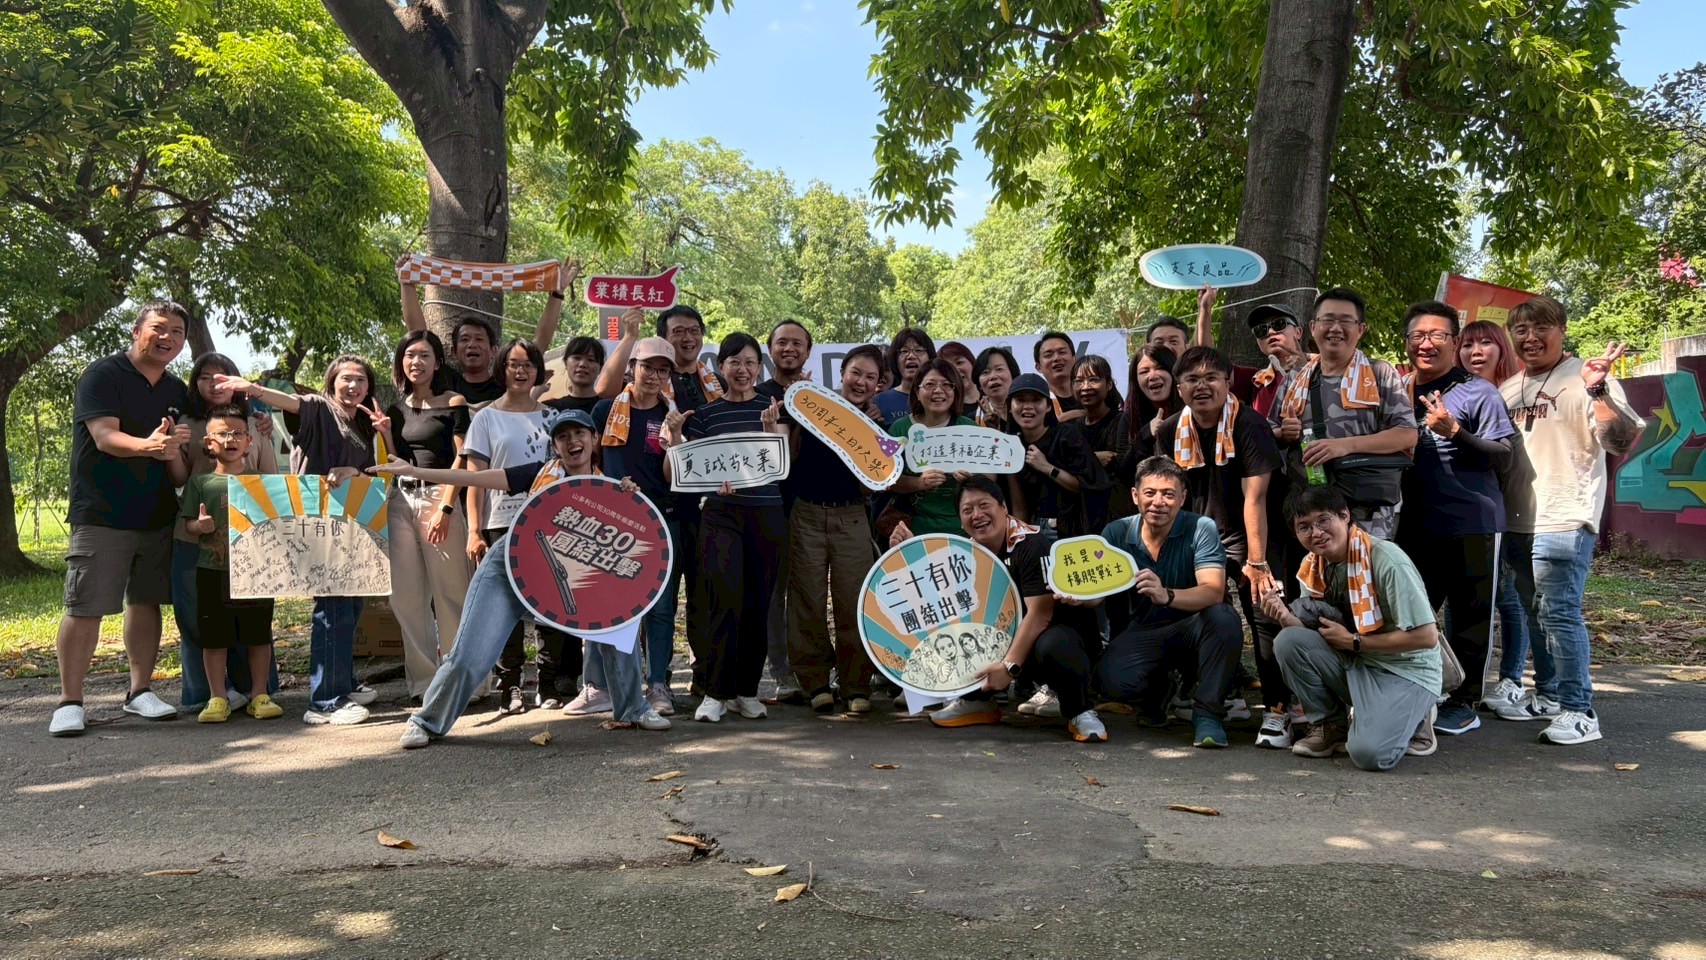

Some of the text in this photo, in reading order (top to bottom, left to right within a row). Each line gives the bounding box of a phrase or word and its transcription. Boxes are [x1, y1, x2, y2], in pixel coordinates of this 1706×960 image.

[595, 281, 664, 303] 業績長紅
[607, 316, 619, 341] FRON
[889, 409, 910, 418] YOS
[682, 448, 775, 478] 真誠敬業
[920, 442, 1000, 460] 打造幸福企業
[282, 518, 345, 538] 三十有你
[552, 505, 636, 551] 熱血30
[550, 530, 642, 578] 團結出擊
[1063, 548, 1090, 567] 我是
[881, 553, 972, 609] 三十有你
[1067, 562, 1123, 587] 橡膠戰士
[900, 588, 975, 634] 團結出擊
